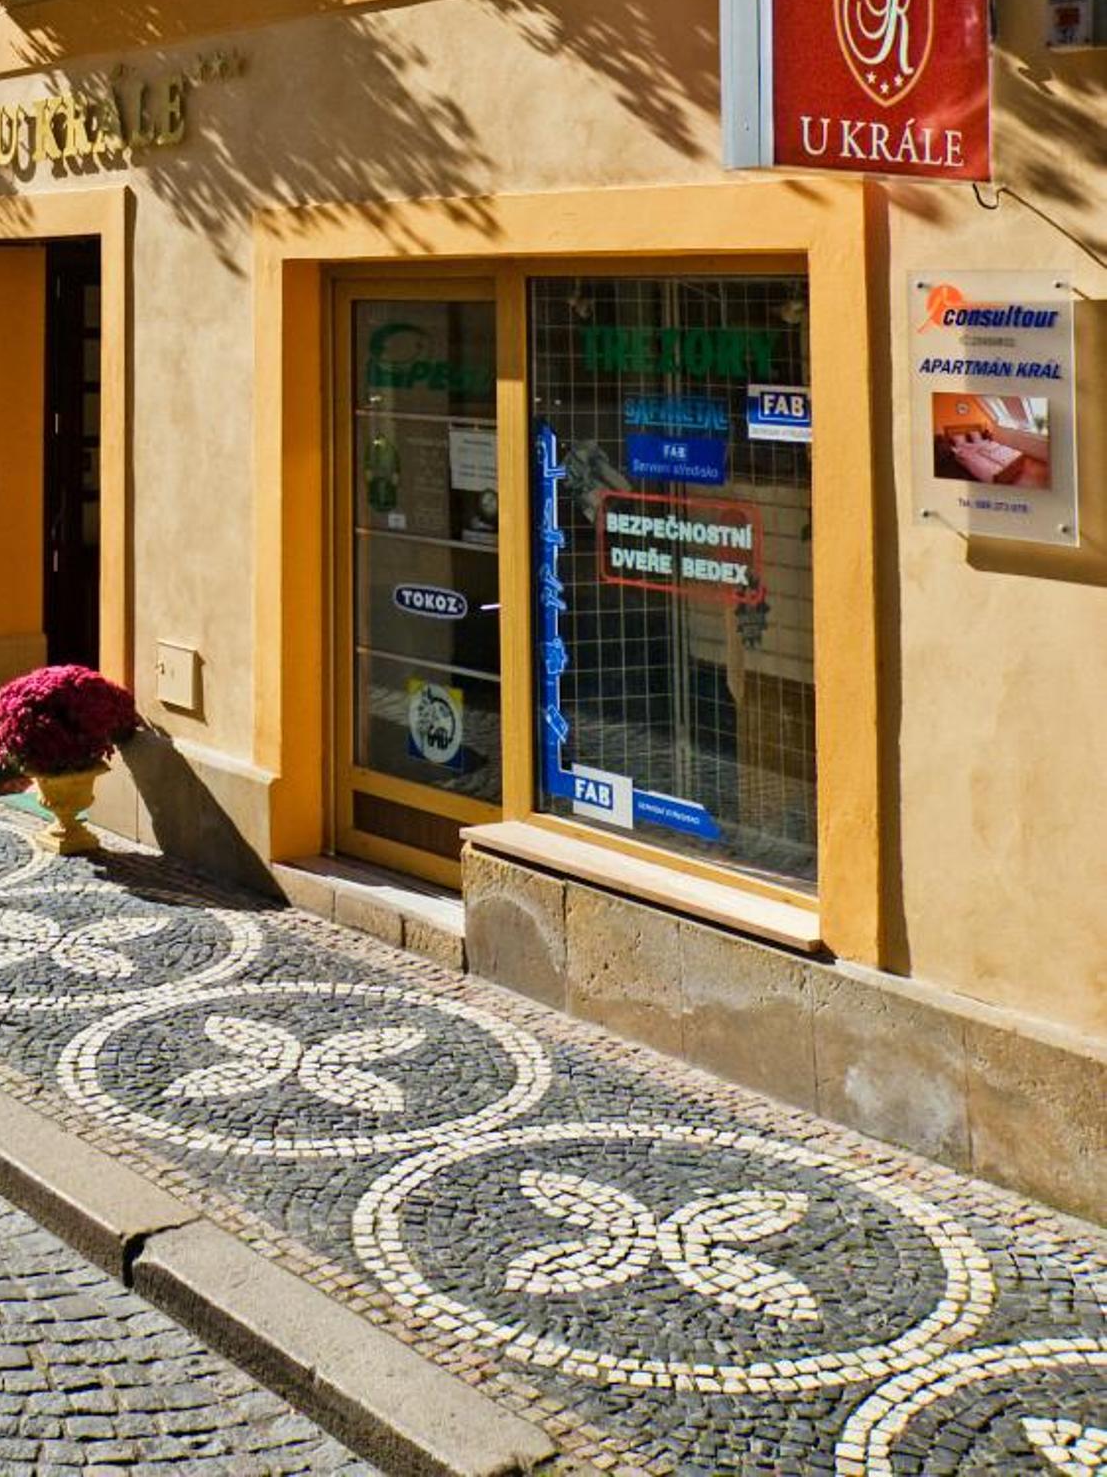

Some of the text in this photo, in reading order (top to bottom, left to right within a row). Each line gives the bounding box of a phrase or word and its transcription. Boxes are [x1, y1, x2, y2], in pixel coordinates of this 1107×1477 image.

[33, 63, 189, 161] KRÁLE
[800, 115, 965, 167] U KRÁLE
[943, 305, 1059, 328] consultour
[919, 357, 1012, 377] APARTMÁN
[763, 393, 804, 417] FAB
[663, 443, 687, 459] FAB
[606, 512, 753, 549] BEZPEČNOSTNÍ
[611, 547, 749, 585] DVEŘE BEDEX
[402, 590, 458, 613] TOKOZ
[574, 777, 611, 807] FAB
